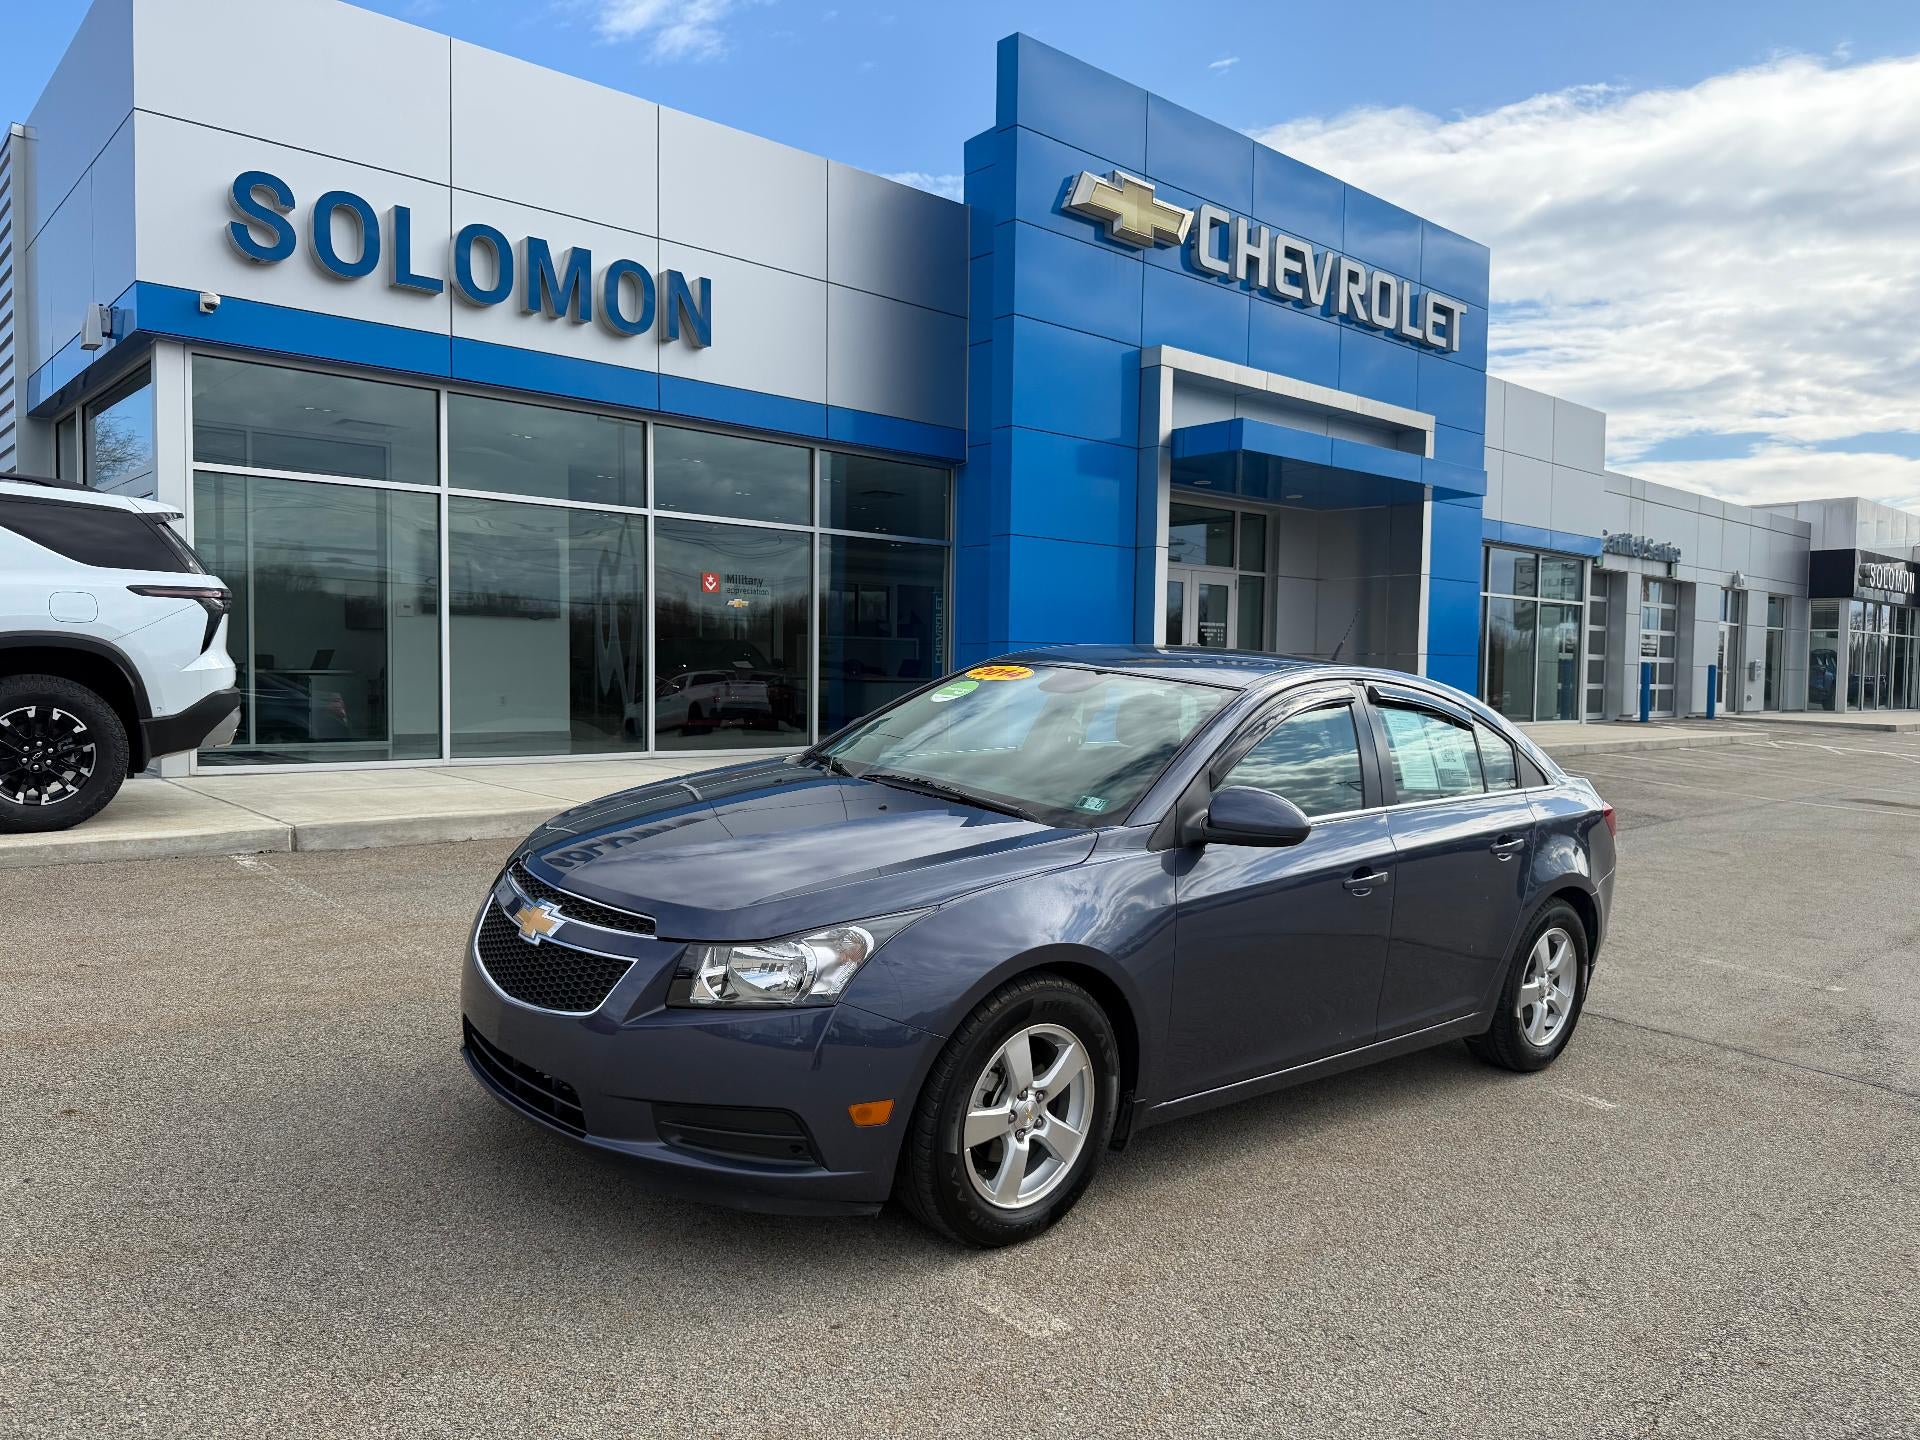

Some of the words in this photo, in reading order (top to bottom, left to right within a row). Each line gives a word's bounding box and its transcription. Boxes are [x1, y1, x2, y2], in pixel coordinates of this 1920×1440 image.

[226, 171, 712, 348] SOLOMON
[1194, 204, 1467, 353] CHEVROLET
[726, 574, 764, 588] Military
[1869, 563, 1915, 594] SOLOMON
[935, 593, 944, 664] CHEVROLET
